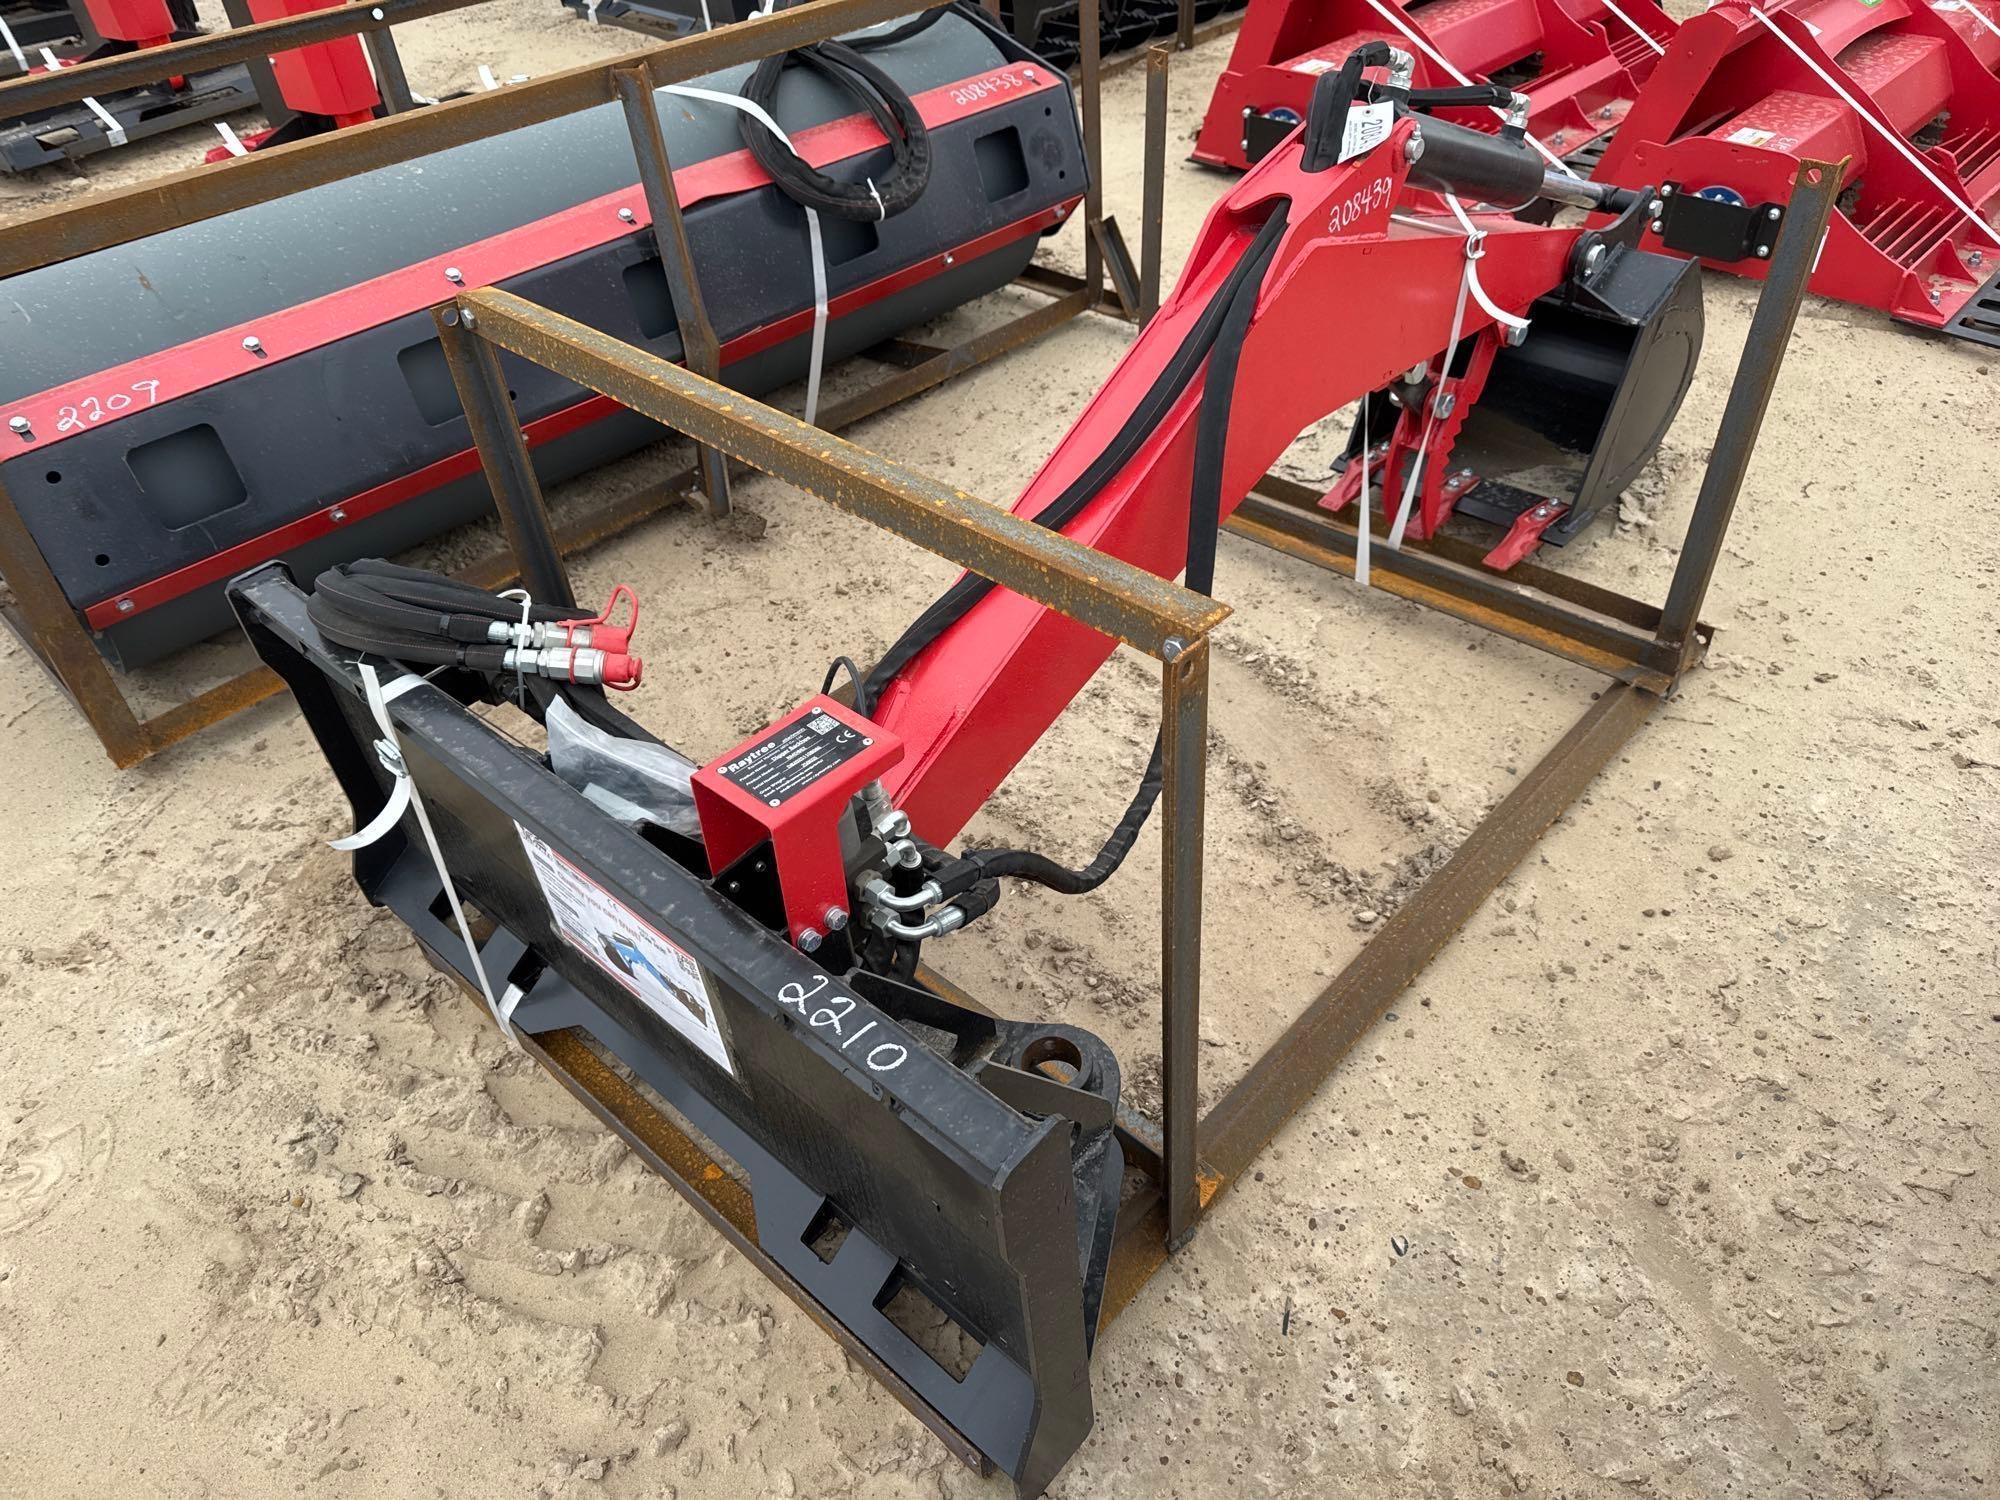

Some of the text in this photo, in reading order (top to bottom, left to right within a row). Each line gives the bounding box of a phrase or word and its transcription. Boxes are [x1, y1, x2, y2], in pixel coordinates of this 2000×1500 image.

[950, 73, 1023, 106] 208438
[1328, 176, 1392, 233] 208439
[56, 379, 160, 432] 2209
[728, 742, 775, 772] Raytree
[777, 974, 908, 1071] 2210
